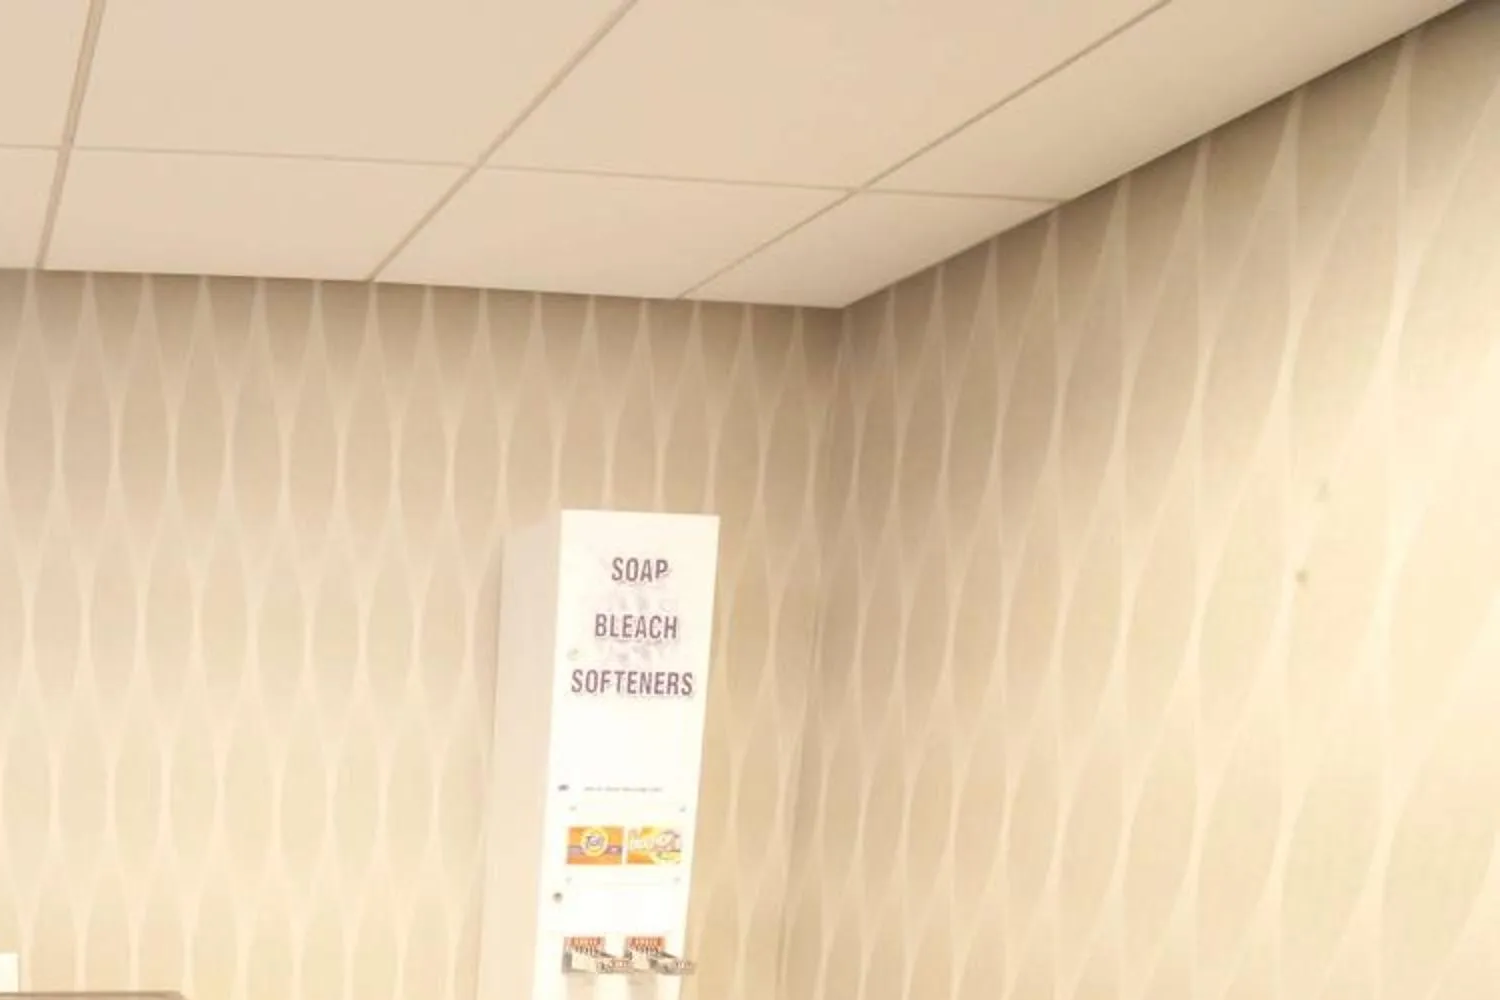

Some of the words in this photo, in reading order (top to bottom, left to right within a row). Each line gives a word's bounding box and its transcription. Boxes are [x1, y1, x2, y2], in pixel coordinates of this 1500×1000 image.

[611, 556, 670, 583] SOAP
[594, 613, 679, 640] BLEACH
[570, 668, 694, 696] SOFTENERS
